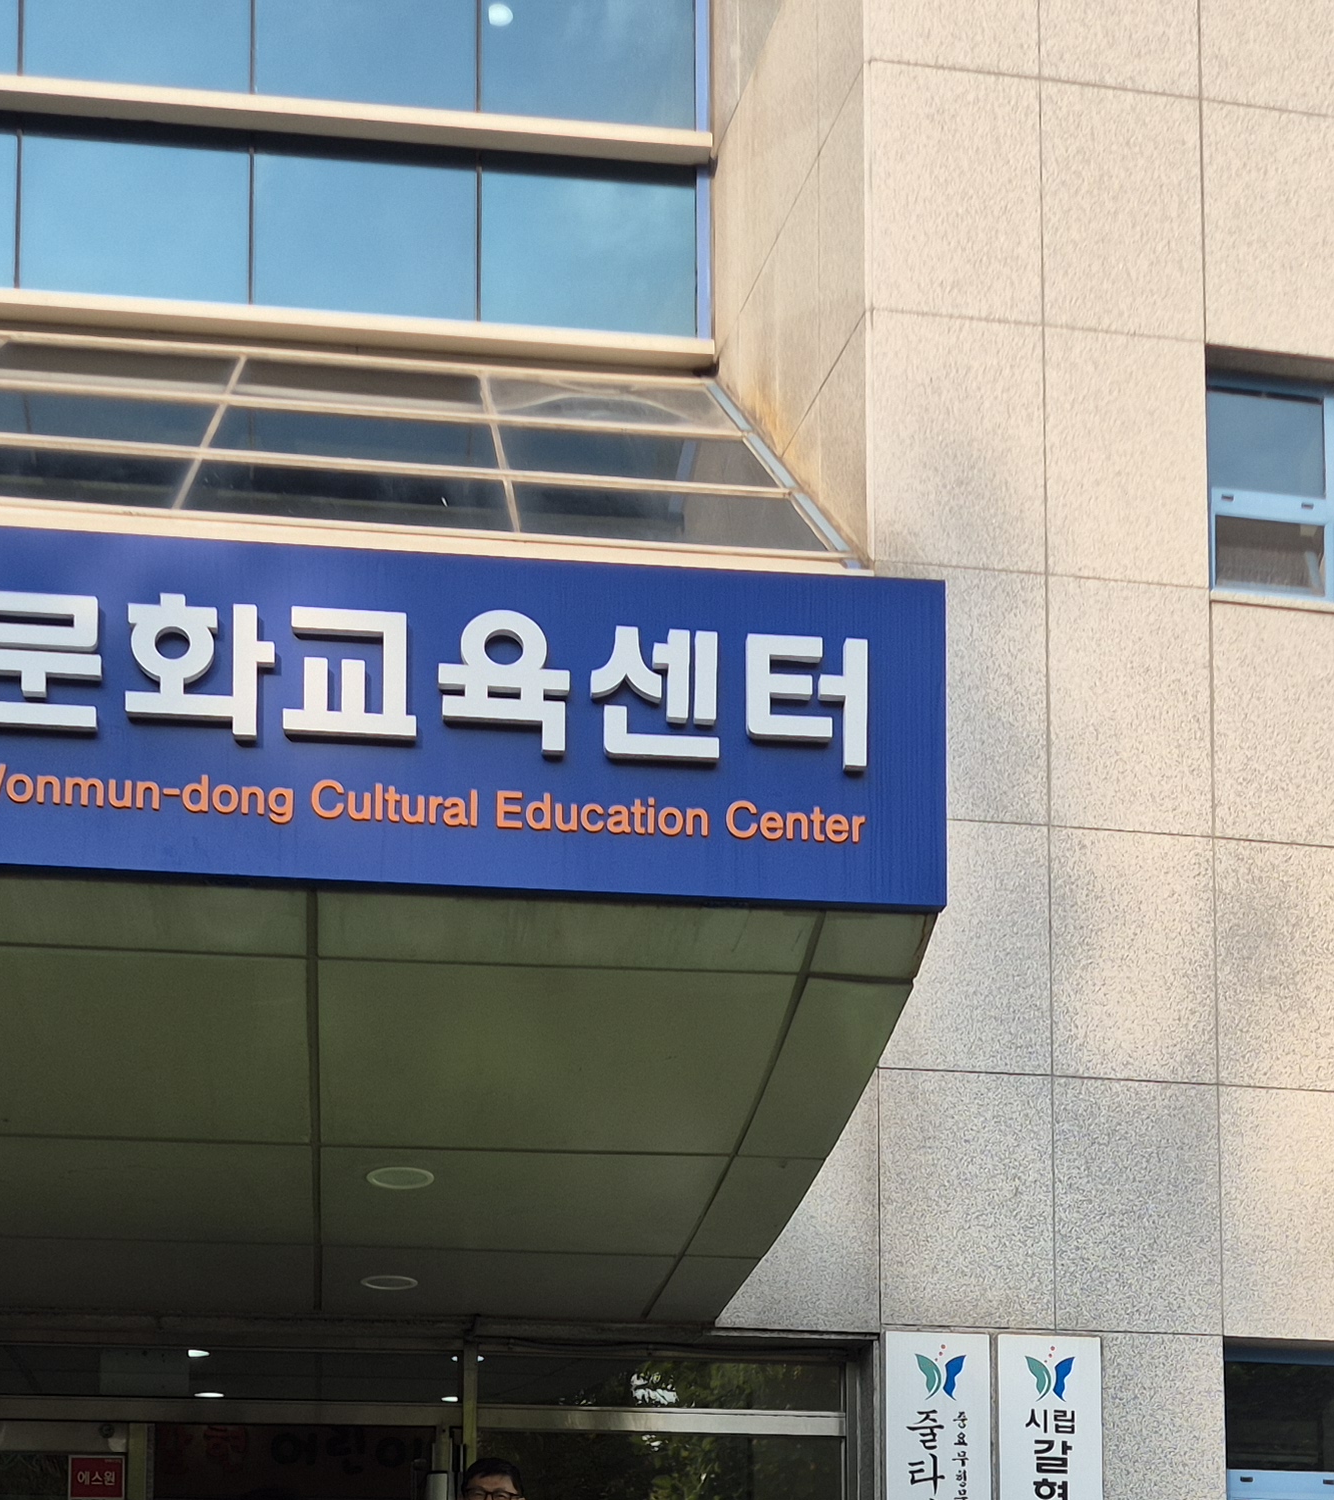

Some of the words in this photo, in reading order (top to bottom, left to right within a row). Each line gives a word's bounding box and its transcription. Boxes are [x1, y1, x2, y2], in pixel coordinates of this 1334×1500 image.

[311, 778, 480, 829] Cultural
[496, 789, 710, 837] Education
[726, 799, 867, 844] Center
[1024, 1408, 1076, 1435] 시립
[77, 1470, 116, 1486] 에스원
